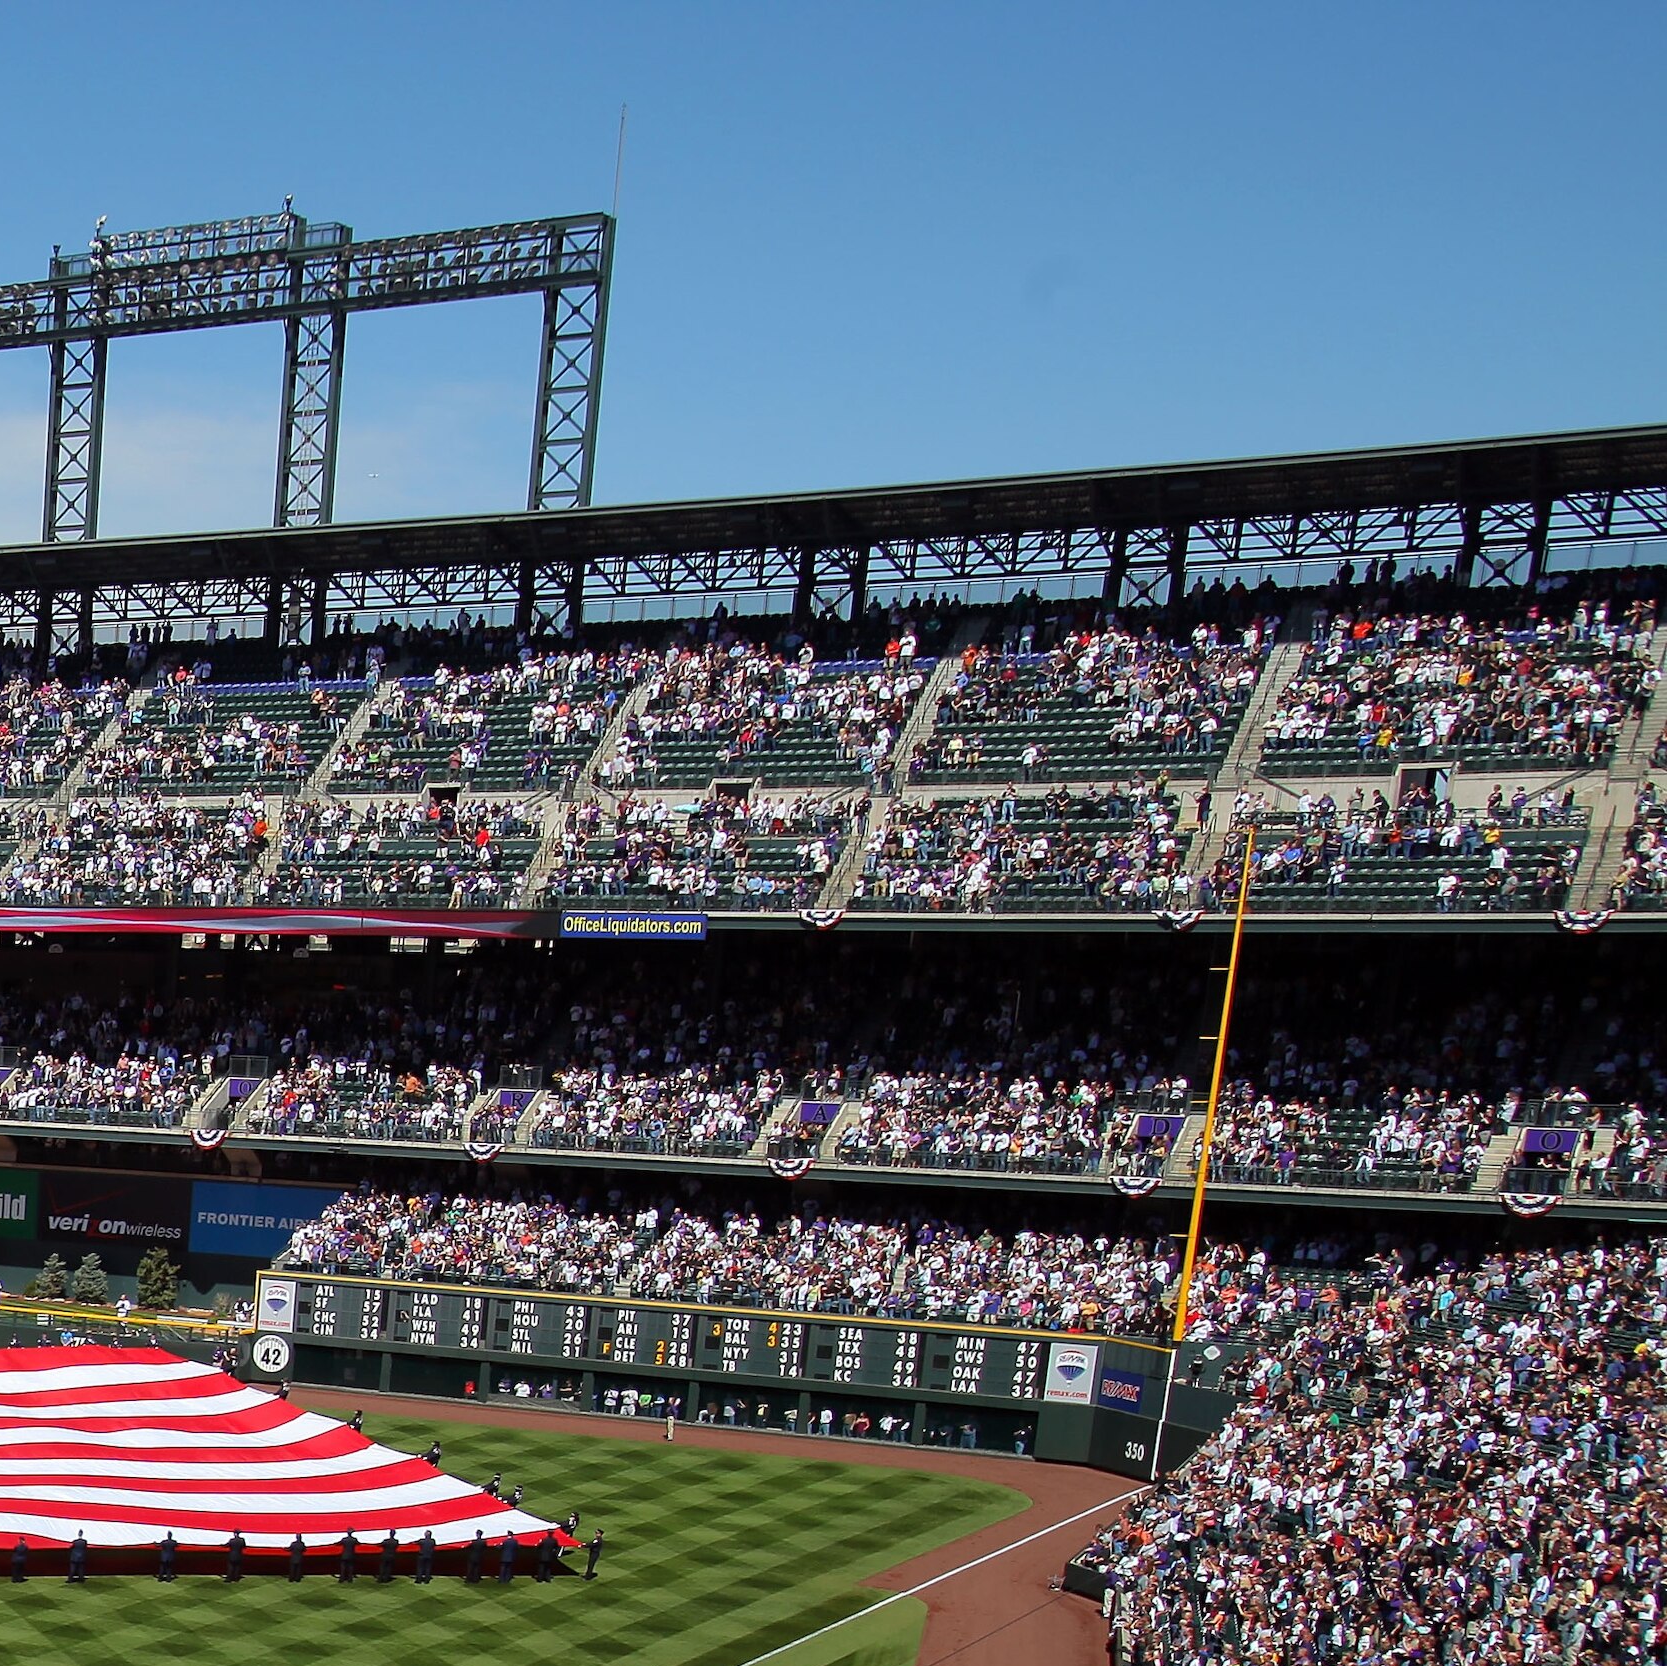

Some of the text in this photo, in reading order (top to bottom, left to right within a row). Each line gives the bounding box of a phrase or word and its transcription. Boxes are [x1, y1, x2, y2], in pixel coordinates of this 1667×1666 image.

[564, 917, 702, 935] OfficeLiquidators.com
[197, 1212, 275, 1229] FRONTIER
[316, 1285, 381, 1300] ATL 15
[414, 1293, 482, 1309] LAD 18
[315, 1297, 381, 1313] SF 57
[413, 1306, 480, 1321] FLA 41
[515, 1301, 585, 1318] PHI 43
[314, 1312, 379, 1327] CHC 52
[513, 1314, 583, 1330] HOU 20
[617, 1310, 691, 1326] PIT 37
[313, 1324, 378, 1340] CIN 34
[412, 1319, 480, 1336] WSH 49
[617, 1323, 690, 1339] ARI 13
[712, 1324, 722, 1336] 3
[727, 1318, 802, 1336] TOR 4 23
[410, 1332, 478, 1348] NYM 34
[512, 1328, 582, 1345] STL 26
[724, 1332, 800, 1348] BAL 3 35
[839, 1327, 918, 1345] SEA 38
[511, 1341, 580, 1357] MIL 31
[602, 1343, 611, 1354] F
[615, 1337, 688, 1354] CLE 2 28
[837, 1340, 916, 1359] TEX 48
[956, 1337, 1040, 1355] MIN 47
[261, 1348, 281, 1365] 42
[614, 1350, 687, 1367] DET 5 48
[723, 1347, 798, 1363] NYY 31
[954, 1350, 1037, 1369] CWS 50
[722, 1360, 798, 1377] TB 14
[835, 1355, 915, 1374] BOS 49
[833, 1370, 913, 1388] KC 34
[952, 1366, 1036, 1385] OAK 47
[951, 1379, 1033, 1399] LAA 32
[1047, 1389, 1088, 1399] remax.com
[1101, 1379, 1140, 1402] RE/MAX
[1125, 1441, 1145, 1461] 350
